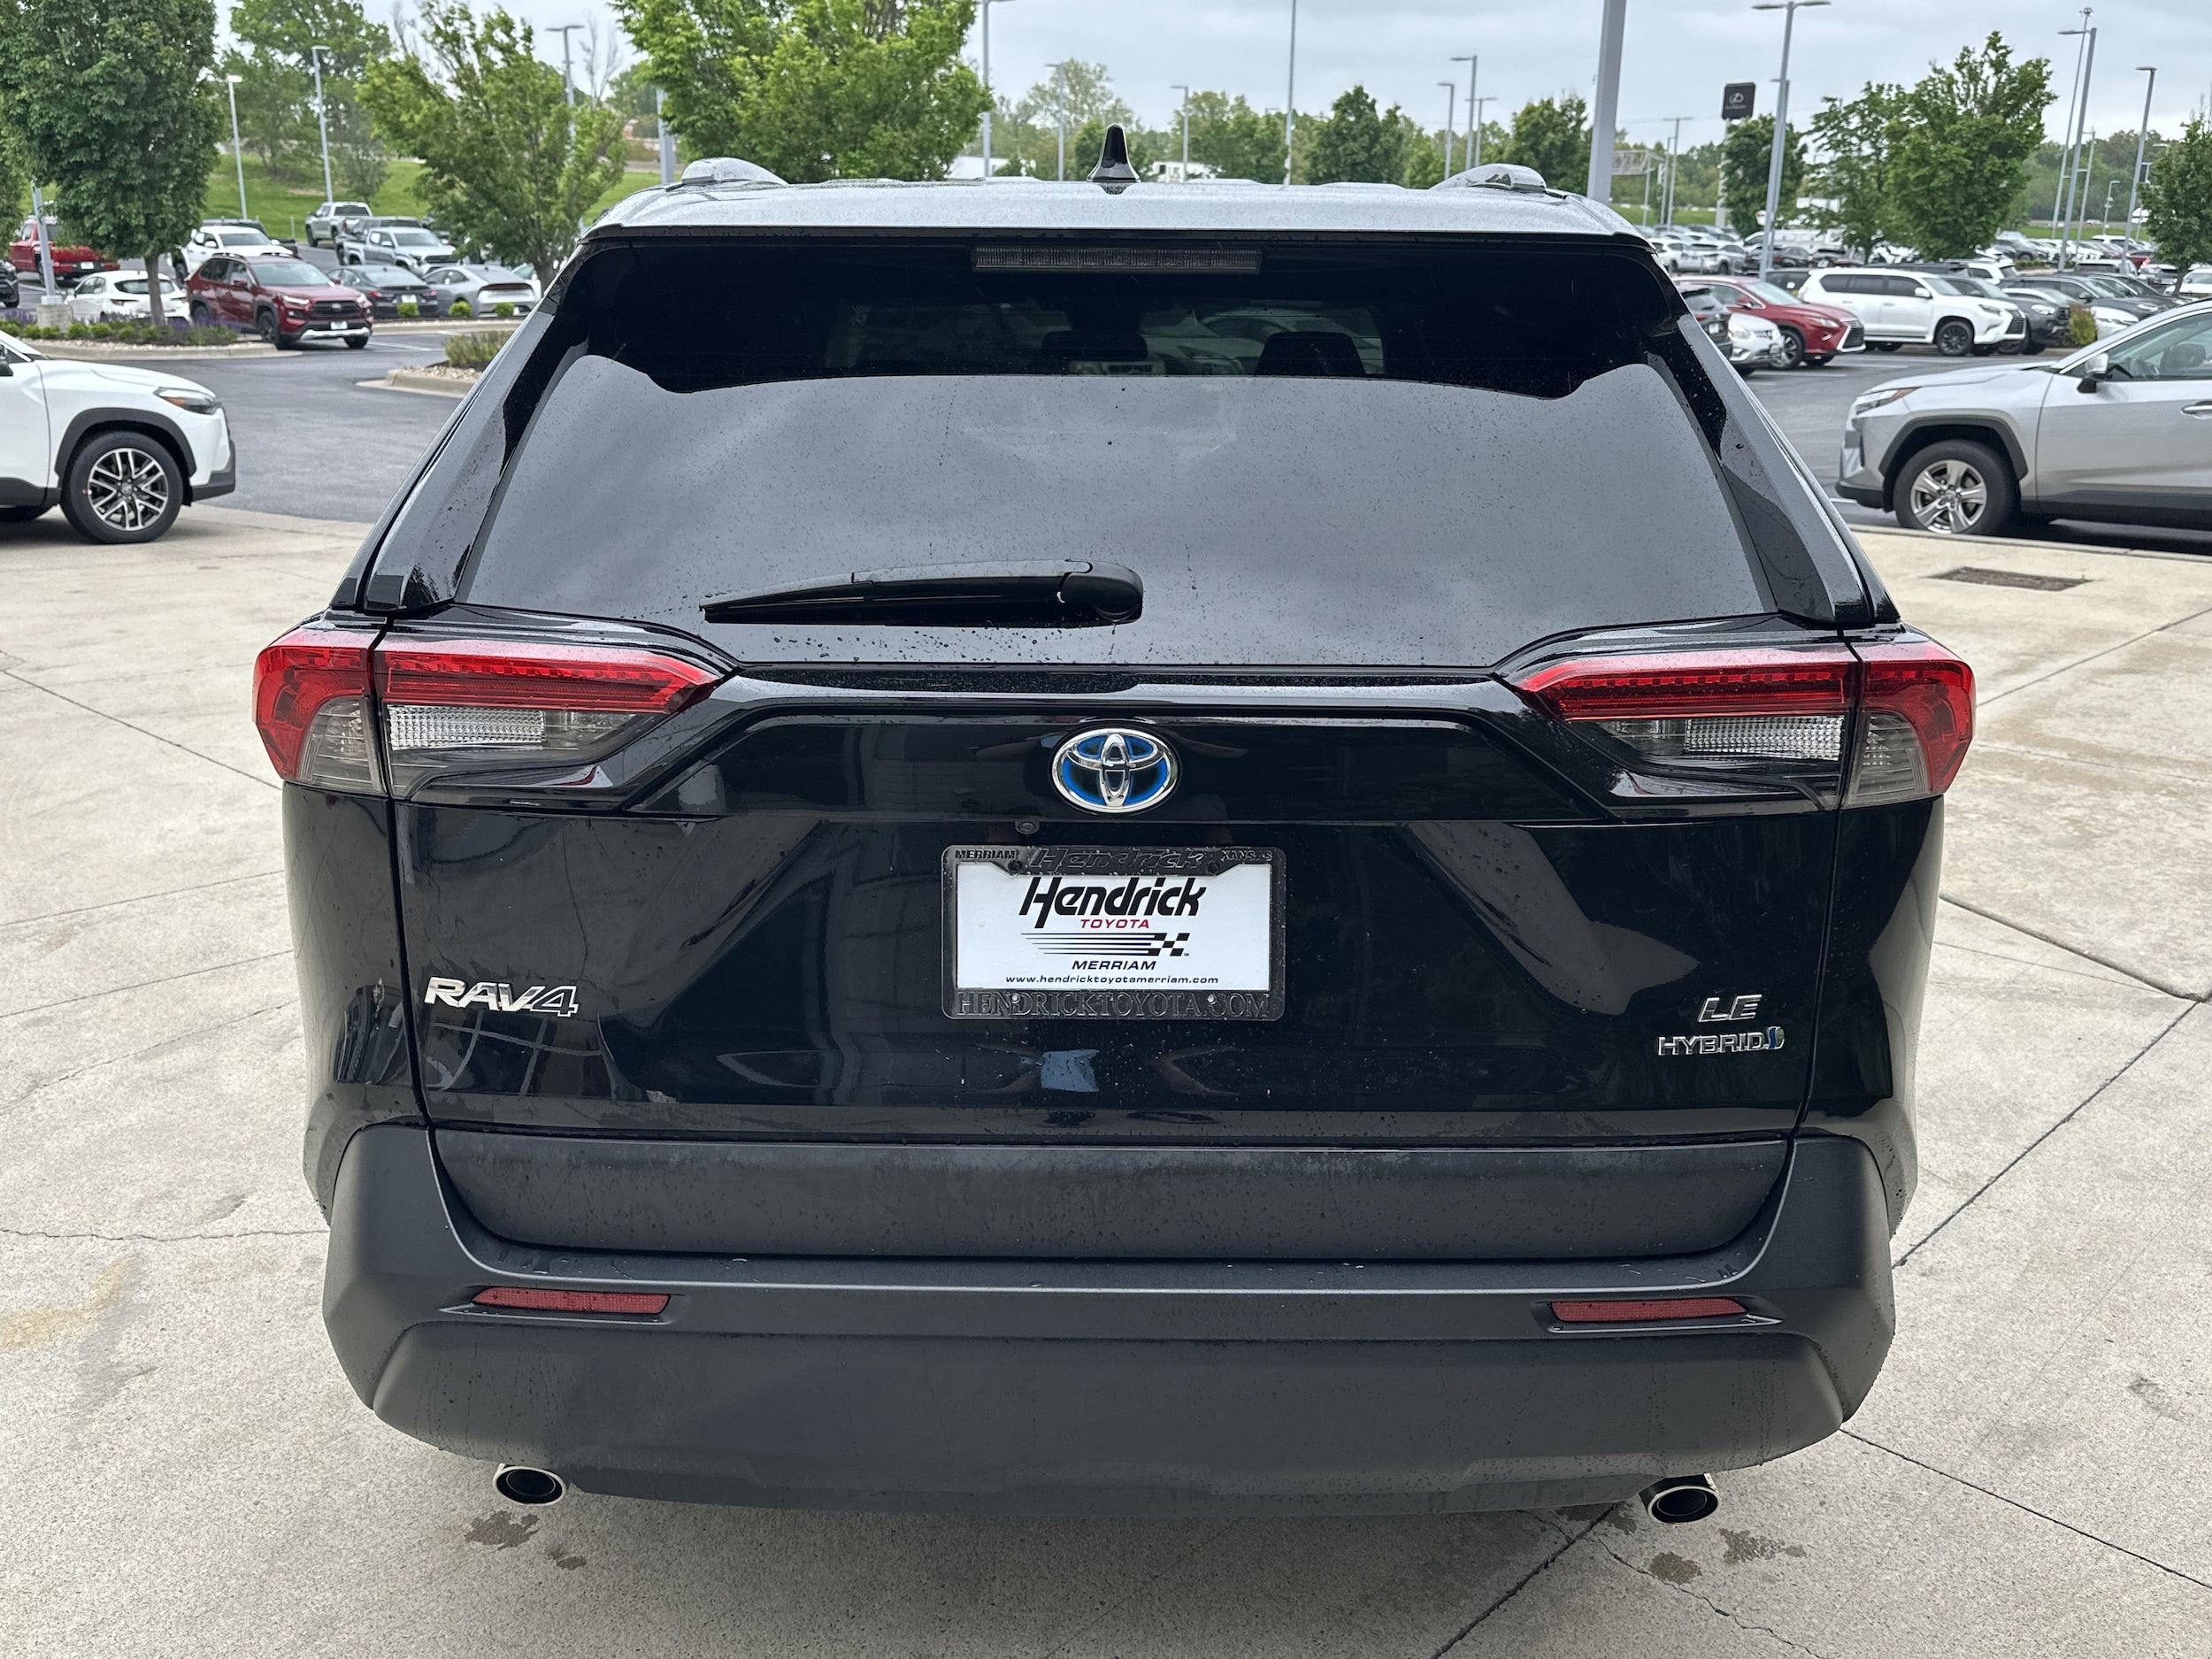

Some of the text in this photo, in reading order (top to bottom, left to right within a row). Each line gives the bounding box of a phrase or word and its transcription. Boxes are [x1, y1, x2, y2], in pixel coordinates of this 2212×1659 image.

[955, 849, 1018, 860] MERRIAM
[1030, 848, 1204, 873] Hendrick
[1221, 849, 1273, 862] KANSAS
[1018, 877, 1207, 929] Hendrick
[1080, 918, 1150, 929] TOYOTA
[1071, 960, 1157, 971] MERRIAM
[1005, 974, 1219, 985] www.hendricktoyotamerriam.com
[424, 977, 580, 1018] RAV4
[956, 990, 1271, 1018] HENDRICKTOYOTA.COM
[1697, 994, 1763, 1023] LE
[1657, 1032, 1767, 1056] HYBRID
